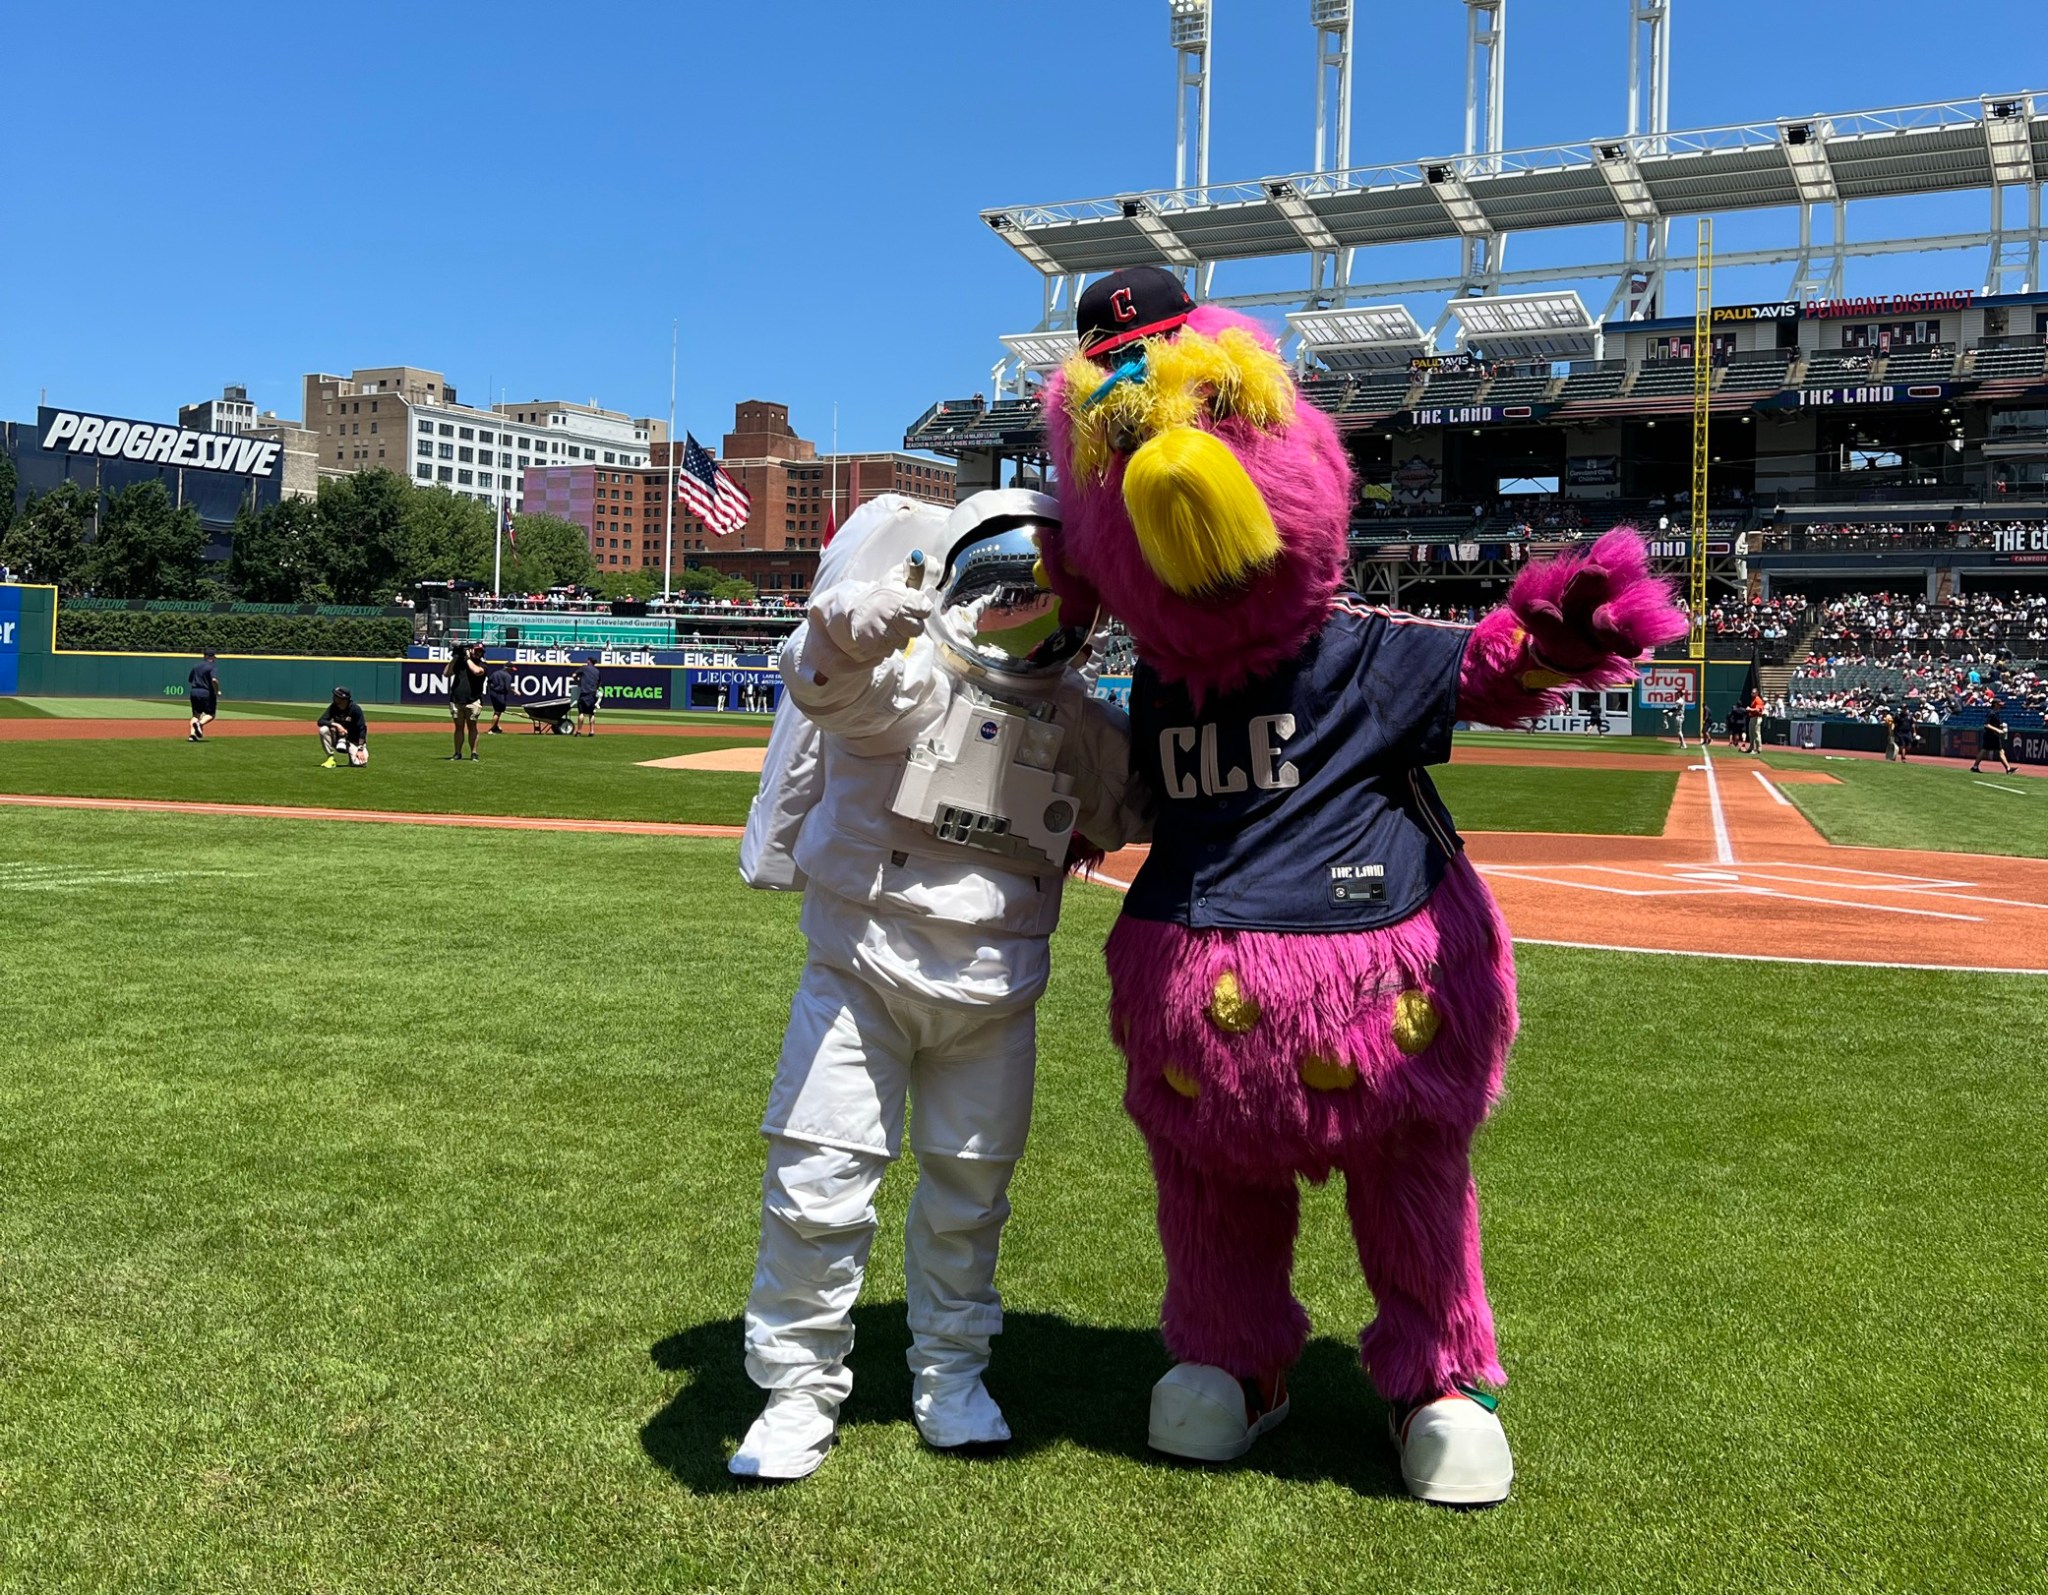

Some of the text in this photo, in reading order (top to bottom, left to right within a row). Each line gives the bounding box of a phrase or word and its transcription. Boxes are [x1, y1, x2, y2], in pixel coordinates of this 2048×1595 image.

[1110, 287, 1137, 322] C
[1805, 290, 1975, 318] PENNANT DISTRICT
[1797, 386, 1894, 405] THE LAND
[1411, 407, 1492, 425] THE LAND
[43, 412, 282, 476] PROGRESSIVE
[1651, 541, 1686, 557] AND
[1993, 531, 2025, 551] THE
[65, 598, 129, 610] ROGRESSIVE
[144, 600, 214, 612] PROGRESSIVE
[230, 602, 300, 614] PROGRESSIVE
[314, 604, 384, 616] PROGRESSIVE
[634, 619, 673, 627] Guardians
[1644, 668, 1686, 690] drug
[163, 685, 184, 696] 400
[1711, 722, 1727, 733] 25
[1159, 713, 1300, 799] CLE
[1331, 864, 1385, 879] THE LAND
